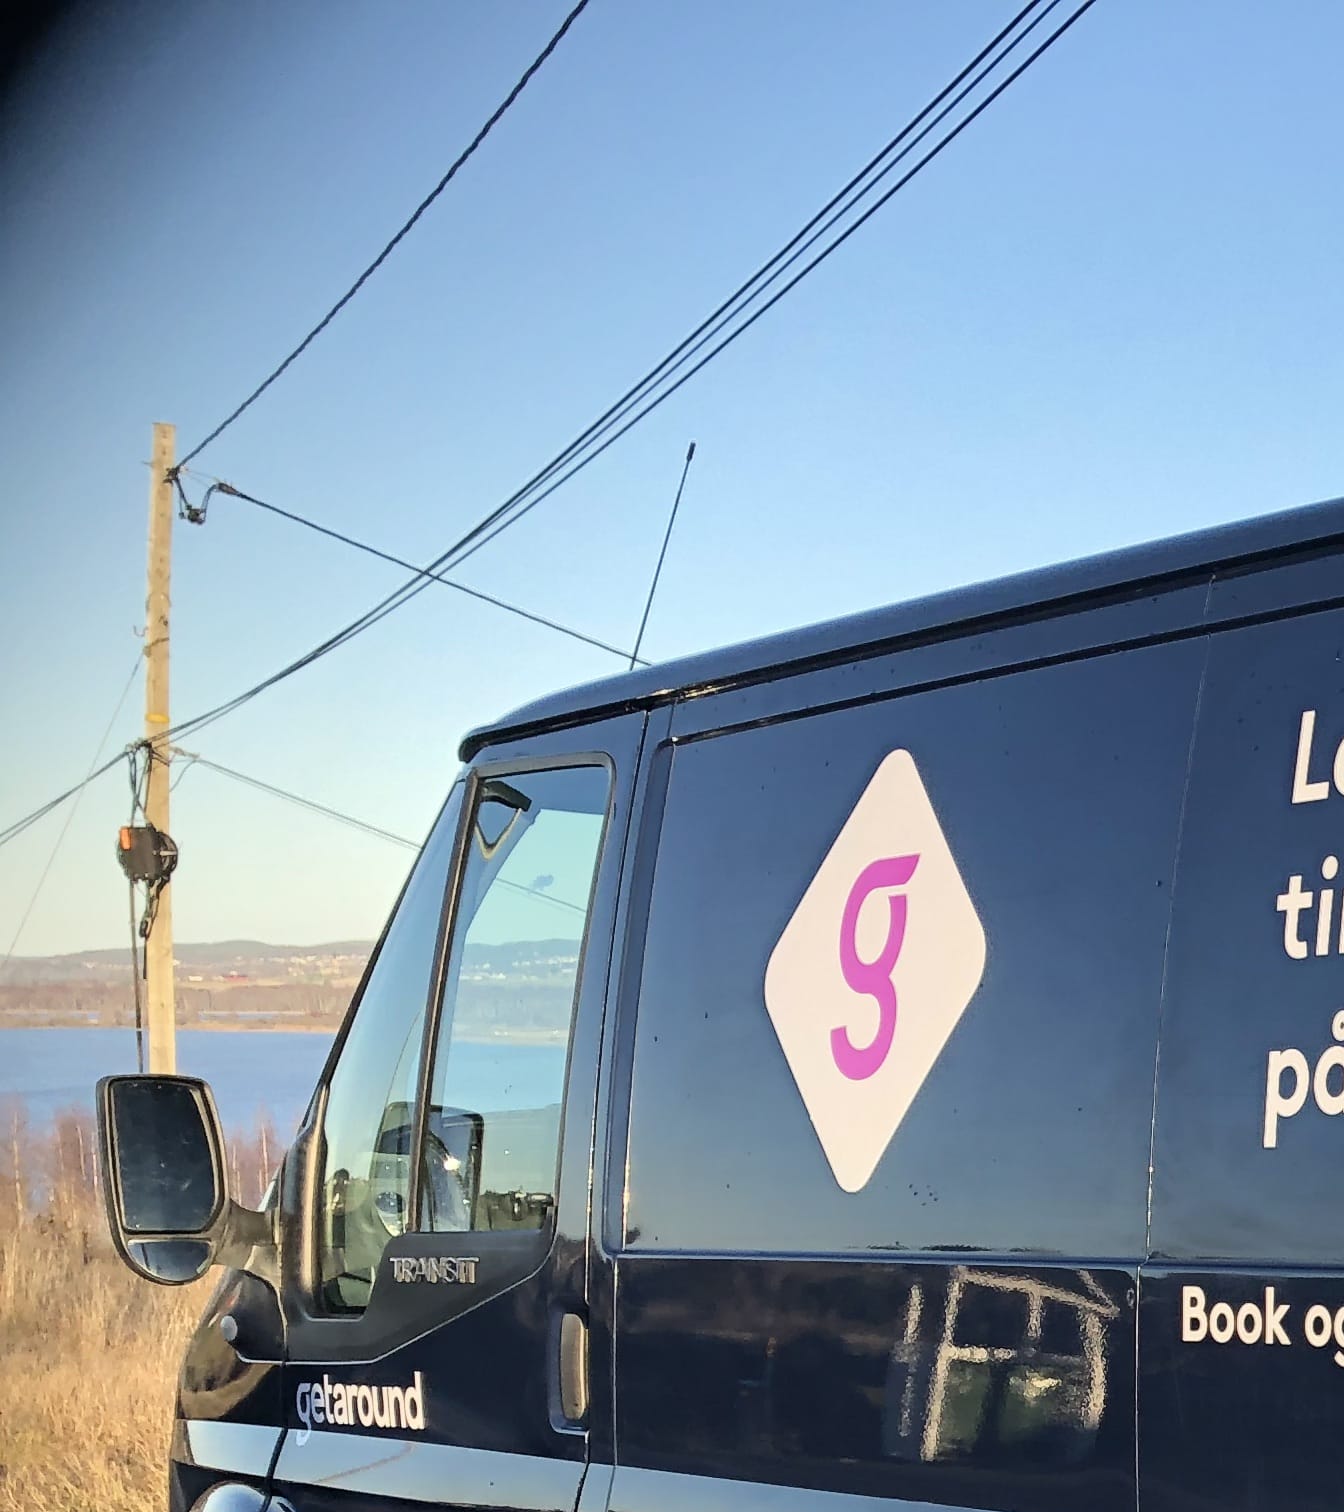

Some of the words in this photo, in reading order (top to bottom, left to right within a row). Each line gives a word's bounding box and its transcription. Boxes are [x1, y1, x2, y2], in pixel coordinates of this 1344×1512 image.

[831, 854, 920, 1080] g
[389, 1257, 480, 1284] TRANSIT
[1181, 1285, 1292, 1346] Book
[296, 1370, 425, 1447] getaround
